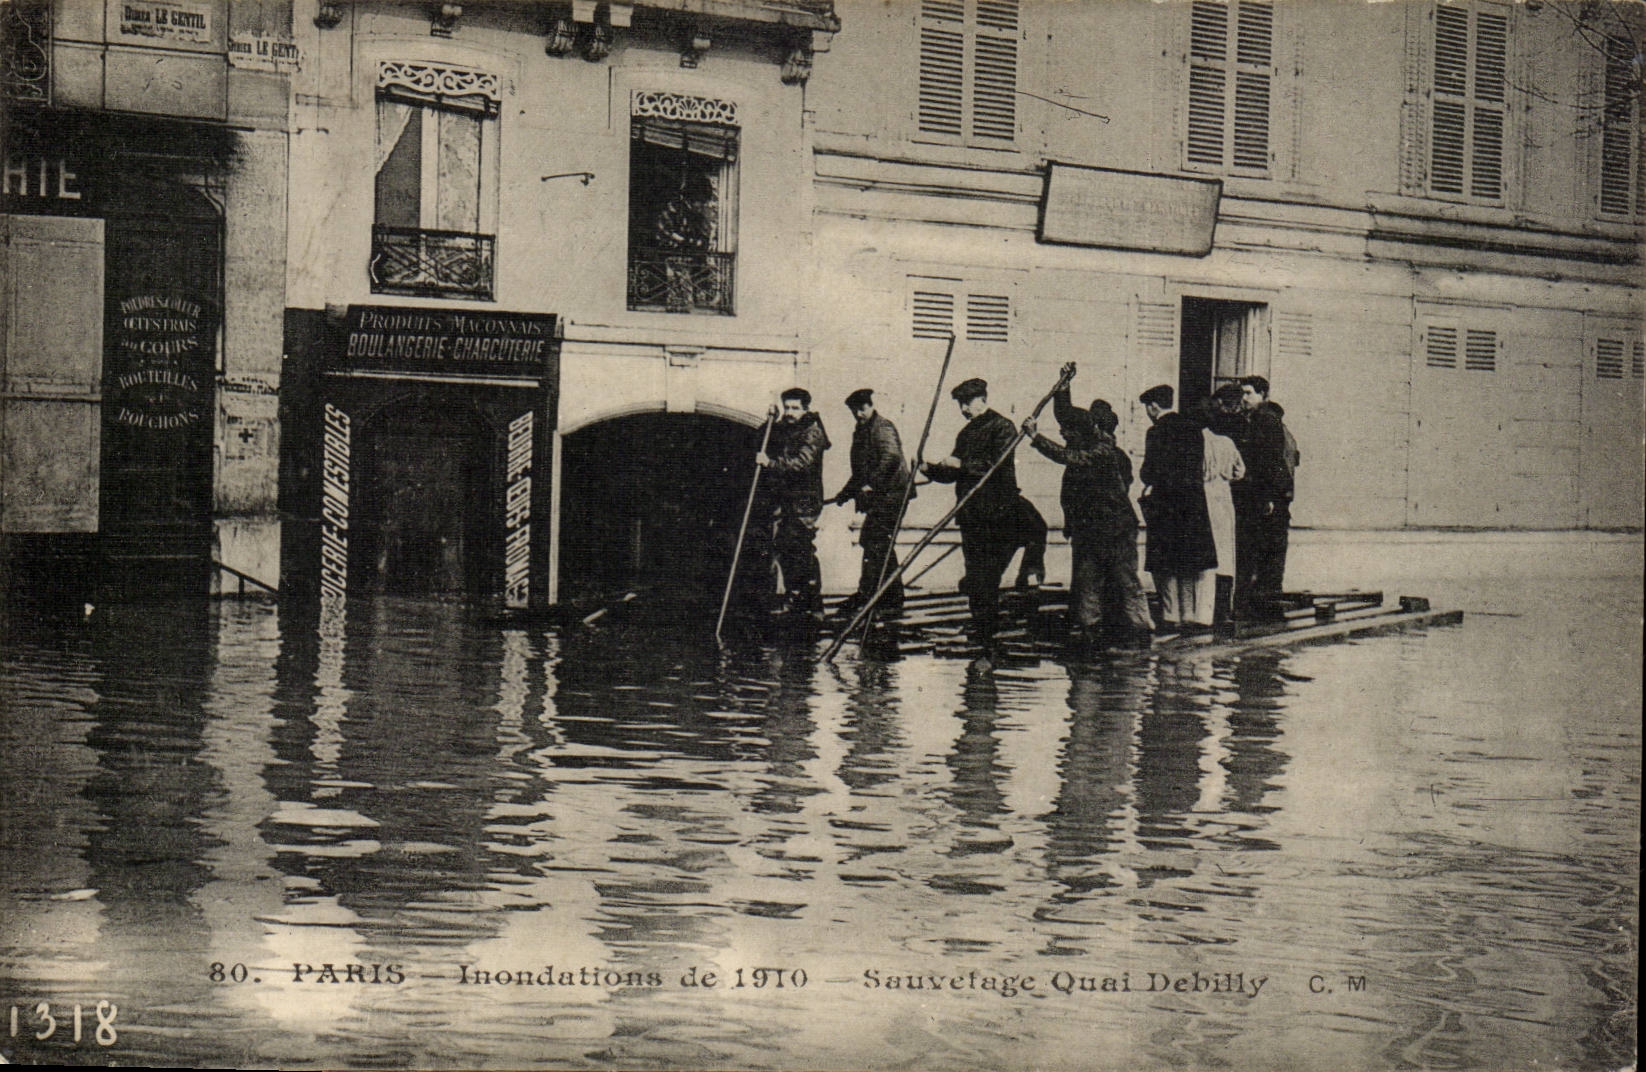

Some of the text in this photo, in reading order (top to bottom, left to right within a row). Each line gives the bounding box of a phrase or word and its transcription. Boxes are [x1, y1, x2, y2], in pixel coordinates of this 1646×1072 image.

[155, 8, 168, 25] LE
[170, 10, 206, 30] GENTIL
[256, 40, 268, 56] LE
[359, 310, 442, 331] PRODUITS
[140, 335, 199, 354] COURS
[347, 332, 546, 364] BOULANGERIE CHARCUTERIE
[118, 407, 200, 429] BOUCHONS
[507, 410, 533, 483] BEURRE
[322, 402, 351, 530] COMESTIBLES
